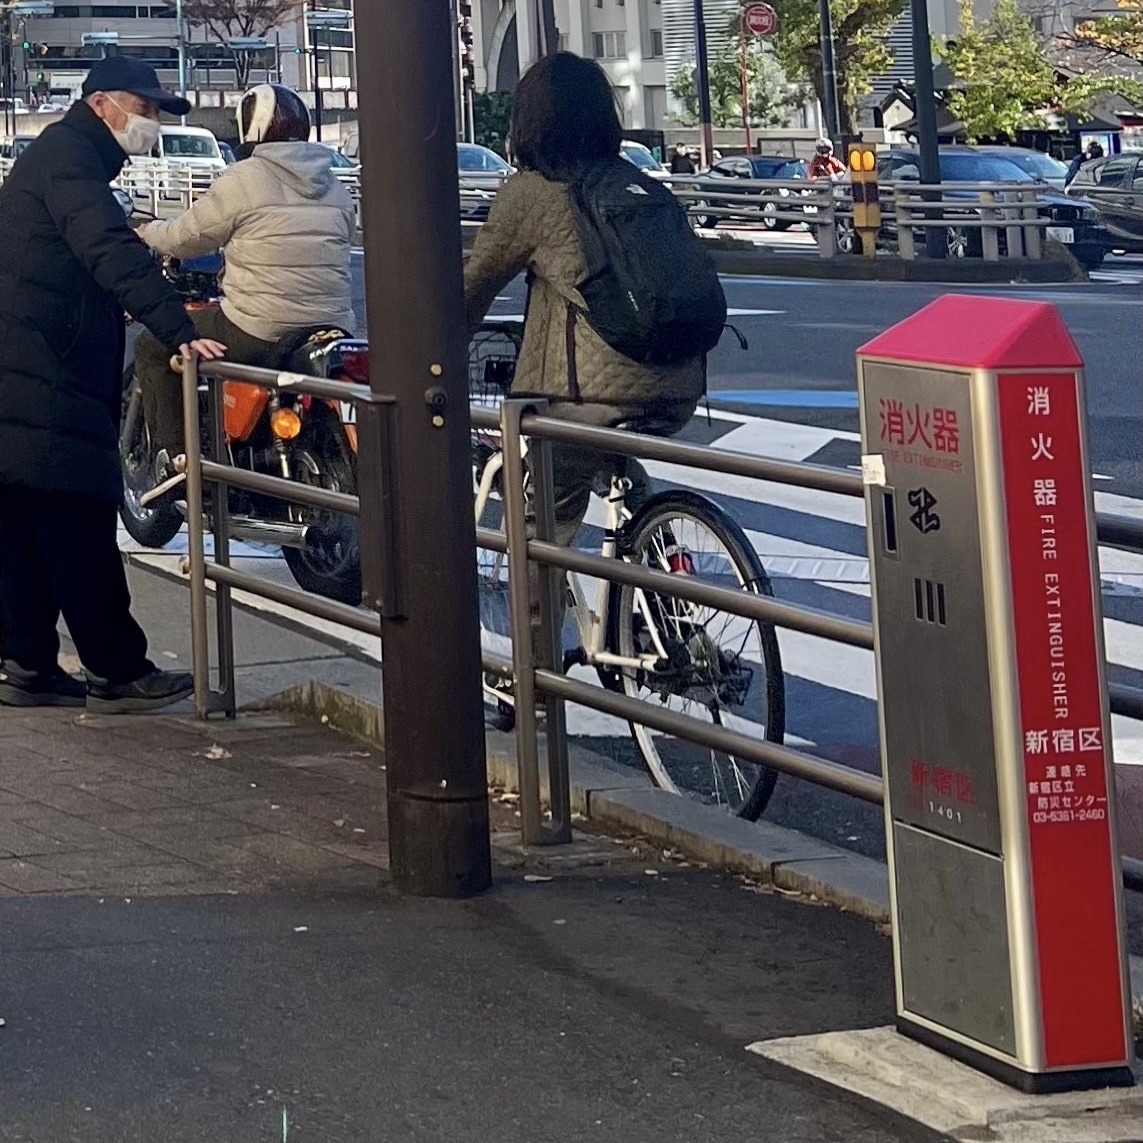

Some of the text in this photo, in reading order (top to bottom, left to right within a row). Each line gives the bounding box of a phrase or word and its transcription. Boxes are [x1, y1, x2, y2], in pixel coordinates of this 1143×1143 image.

[879, 398, 960, 454] 消火器
[1027, 387, 1057, 506] 消火器
[1040, 514, 1069, 720] FIRE EXTINGUISHER
[1026, 727, 1102, 754] 新宿区
[1029, 780, 1075, 794] 新宿区立
[929, 800, 962, 823] 1401
[1037, 794, 1107, 810] 防災センター
